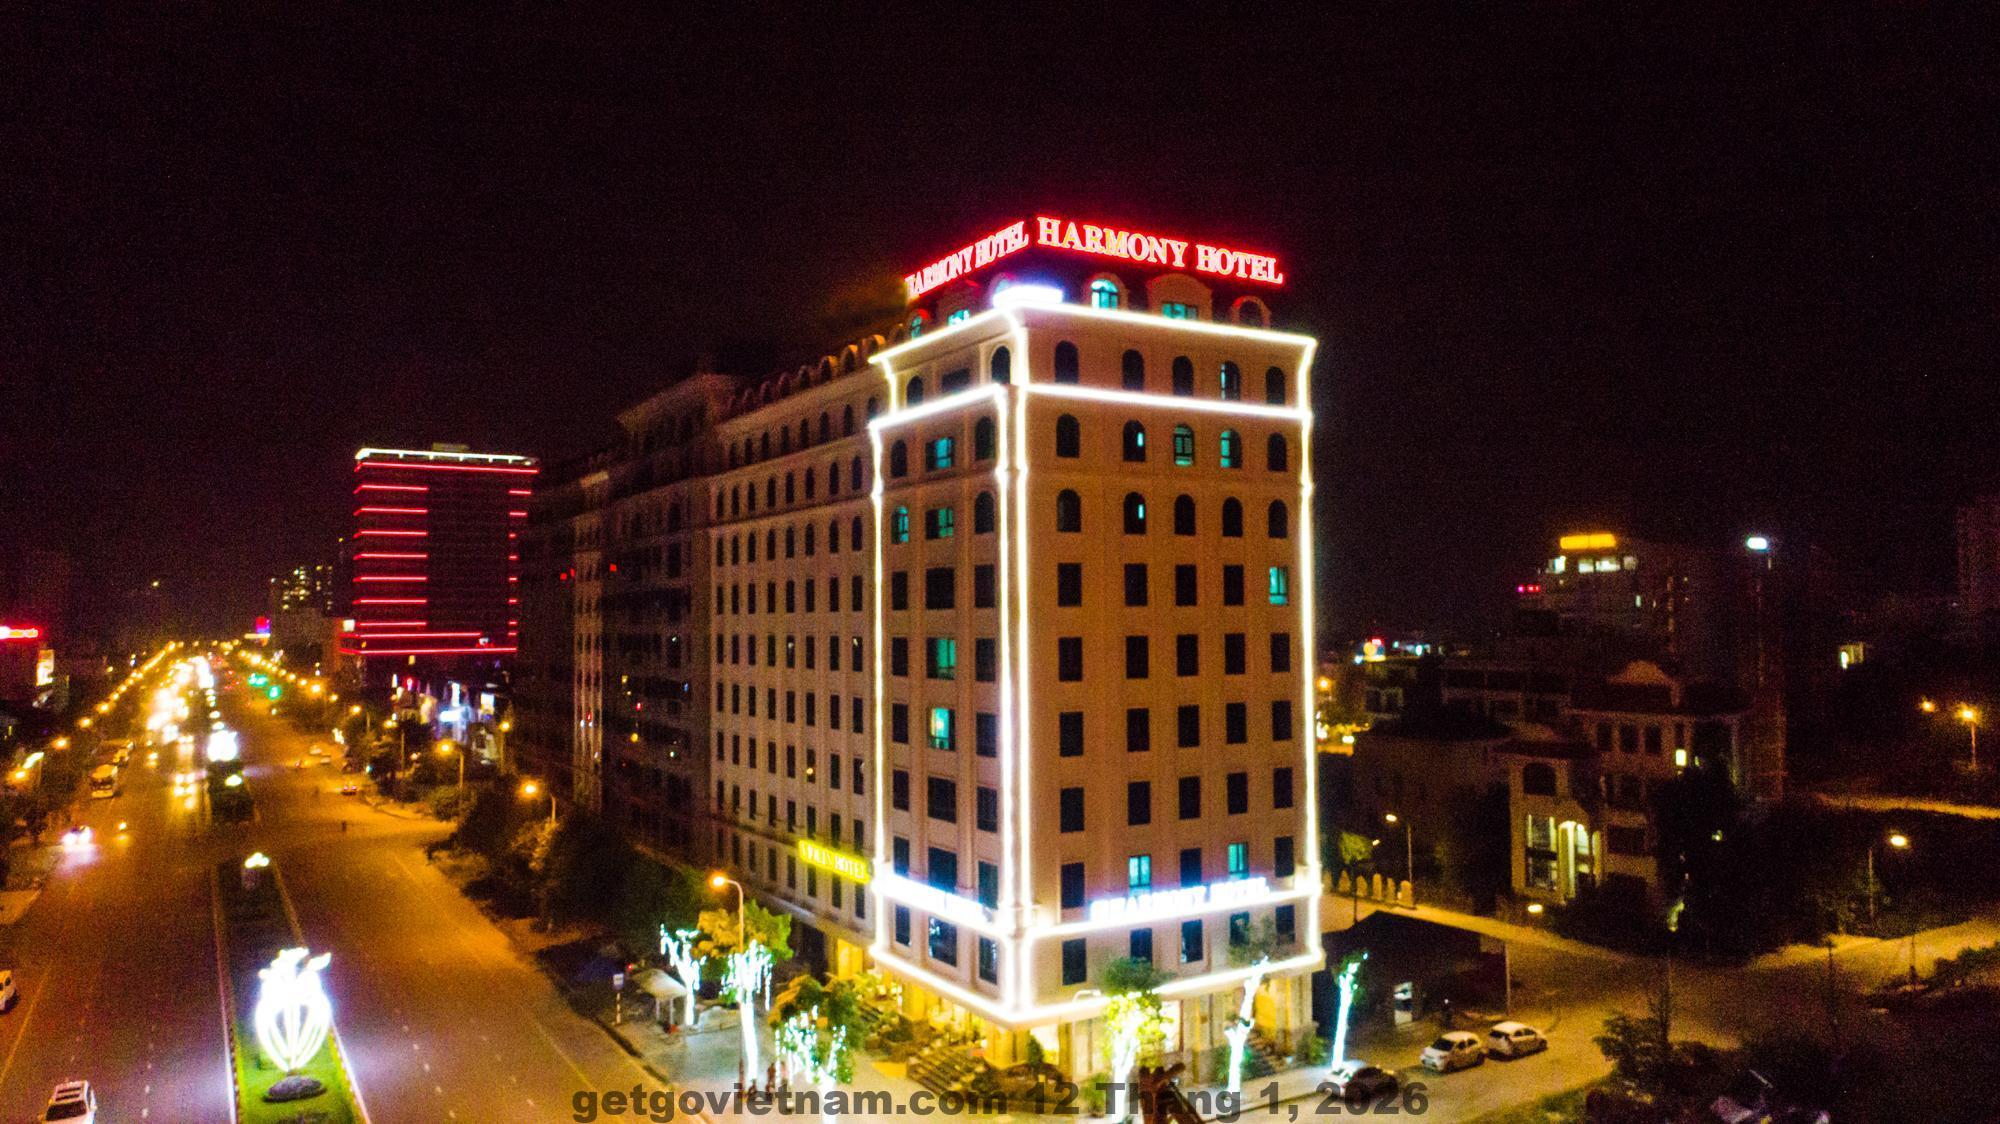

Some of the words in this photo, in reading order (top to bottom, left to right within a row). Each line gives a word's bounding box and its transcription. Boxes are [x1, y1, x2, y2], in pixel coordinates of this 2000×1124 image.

[972, 220, 1029, 268] HOTEL
[1037, 216, 1188, 267] HARMONY
[1195, 244, 1284, 285] HOTEL
